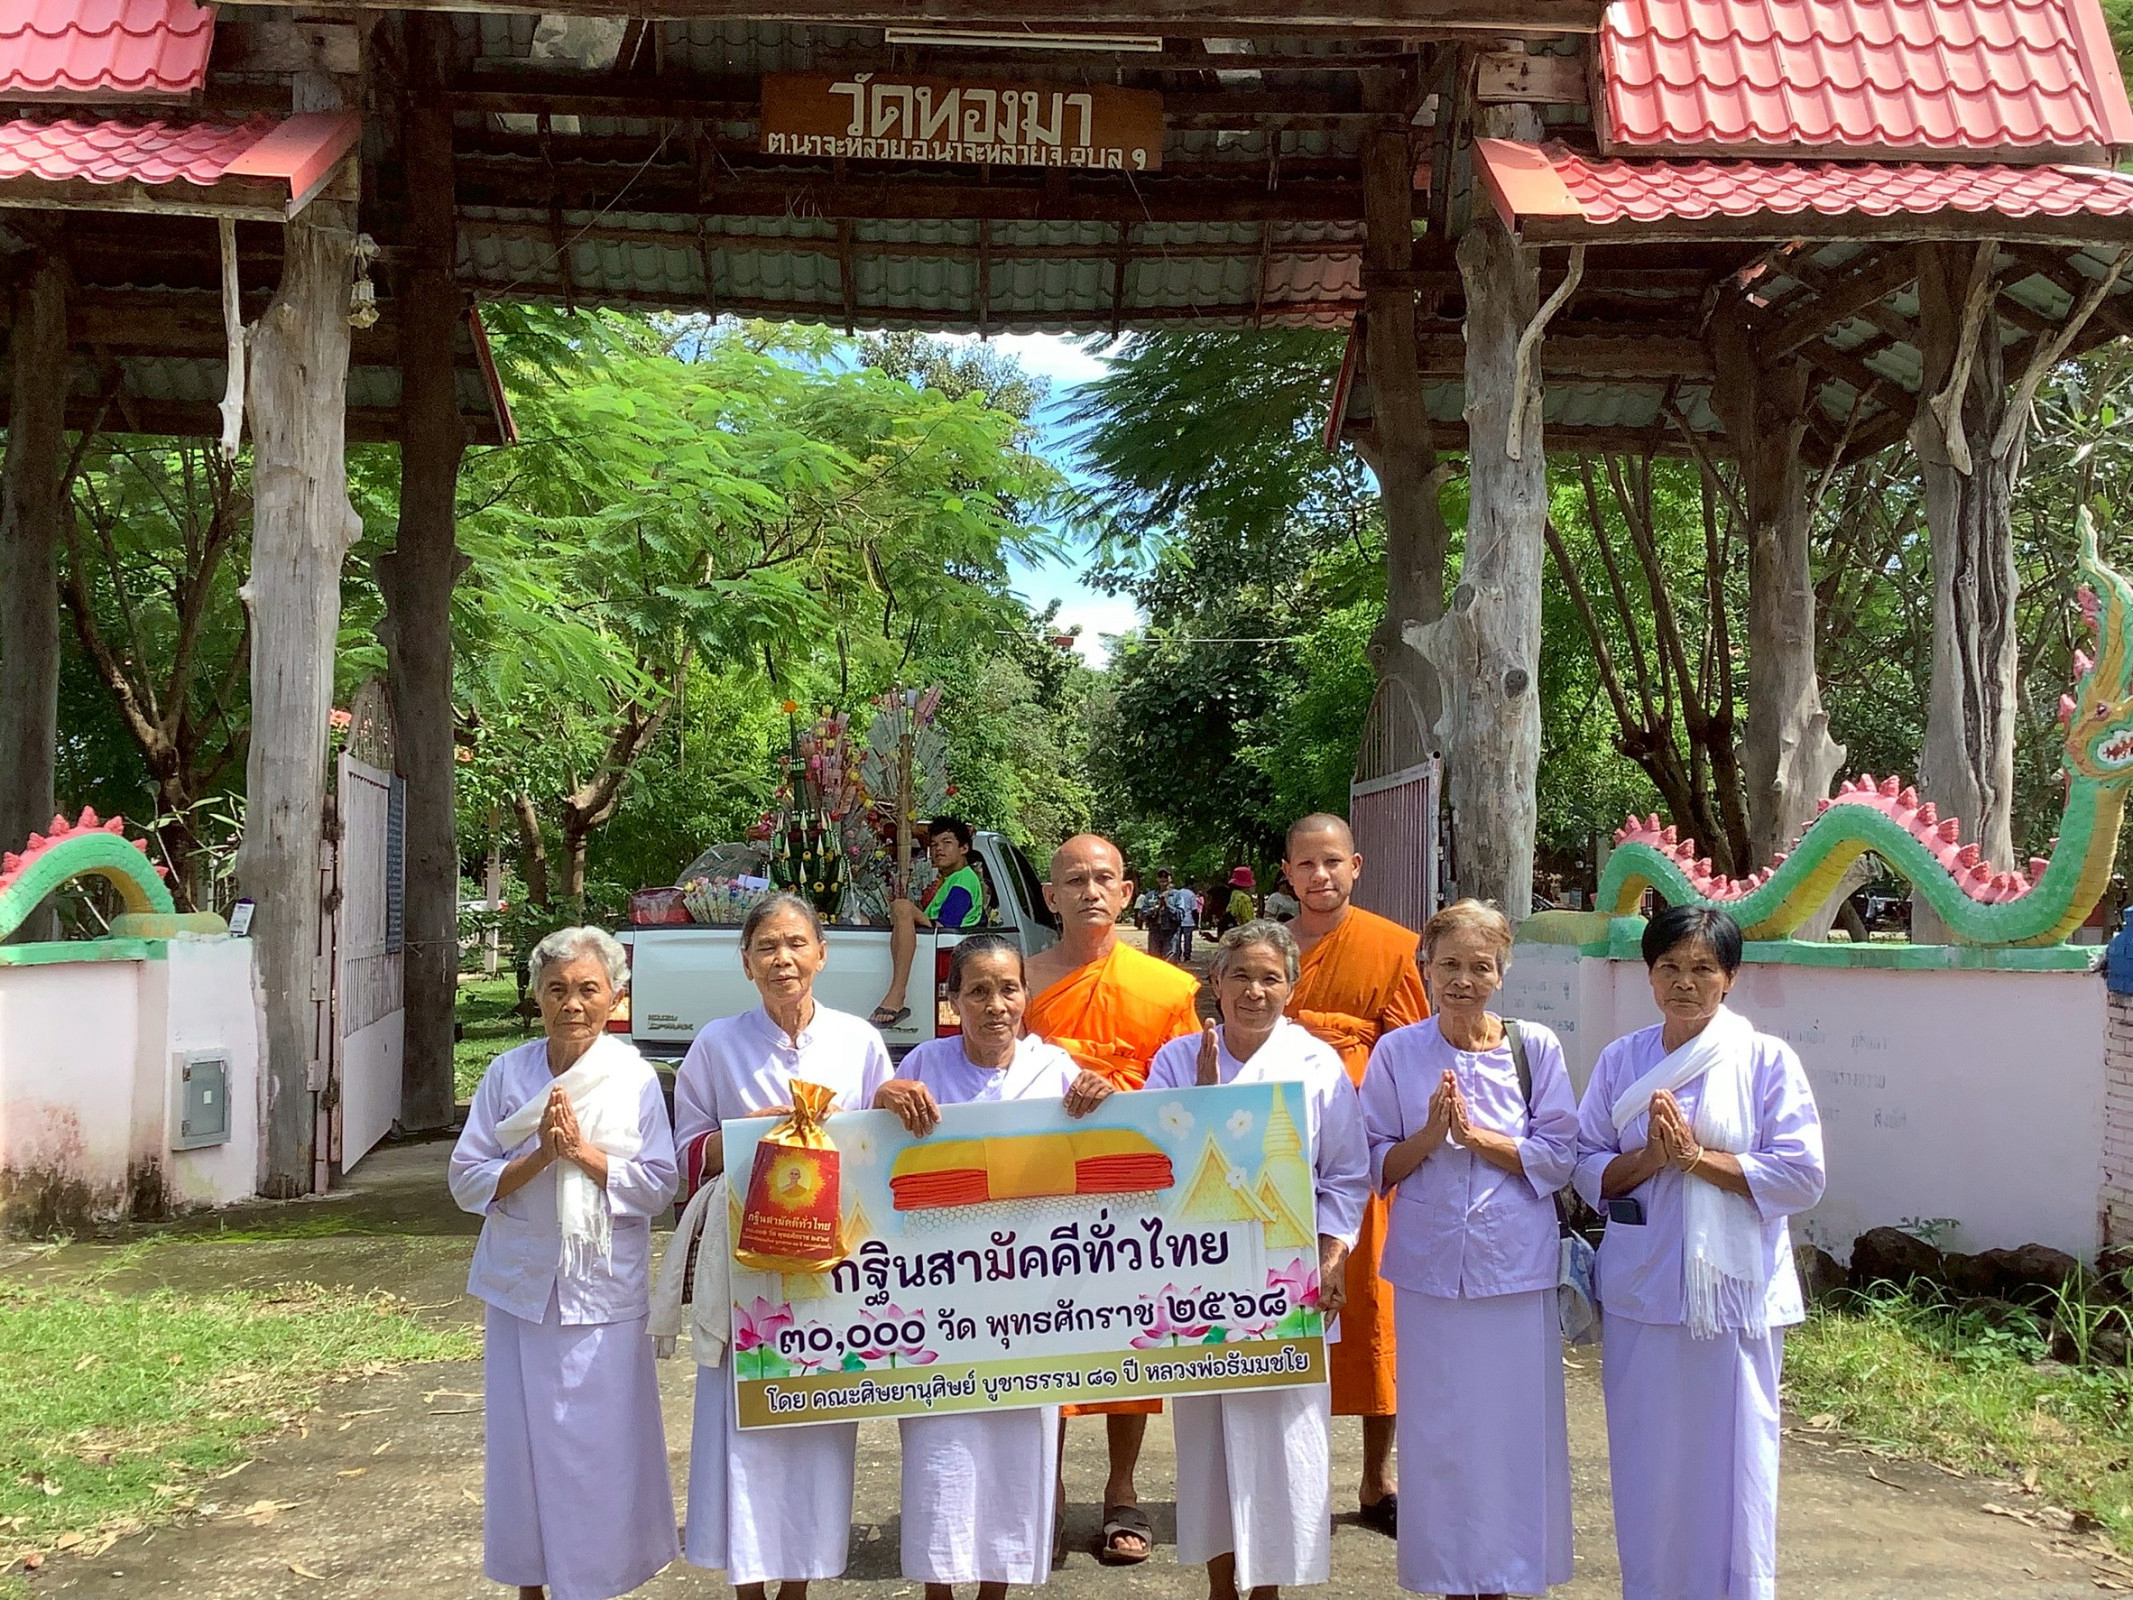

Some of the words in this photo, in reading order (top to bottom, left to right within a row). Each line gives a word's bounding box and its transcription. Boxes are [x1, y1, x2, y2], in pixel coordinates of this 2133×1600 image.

[828, 73, 1093, 147] วัดทองมา
[831, 1208, 1229, 1306] กฐินสามัคคีทั่วไทย
[780, 1320, 926, 1357] ๓๐,๐๐๐
[938, 1308, 976, 1341] วัด
[986, 1299, 1154, 1349] พุทธศักราช
[1166, 1288, 1287, 1323] ๒๕๖๘
[766, 1386, 805, 1412] โดย
[814, 1370, 976, 1408] คณะศิษยานุศิษย์
[982, 1370, 1080, 1402] บูชาธรรม
[1087, 1368, 1118, 1386] ๘๑
[1123, 1357, 1138, 1383] ปี
[1145, 1347, 1308, 1381] หลวงพ่อธัมมชโย
